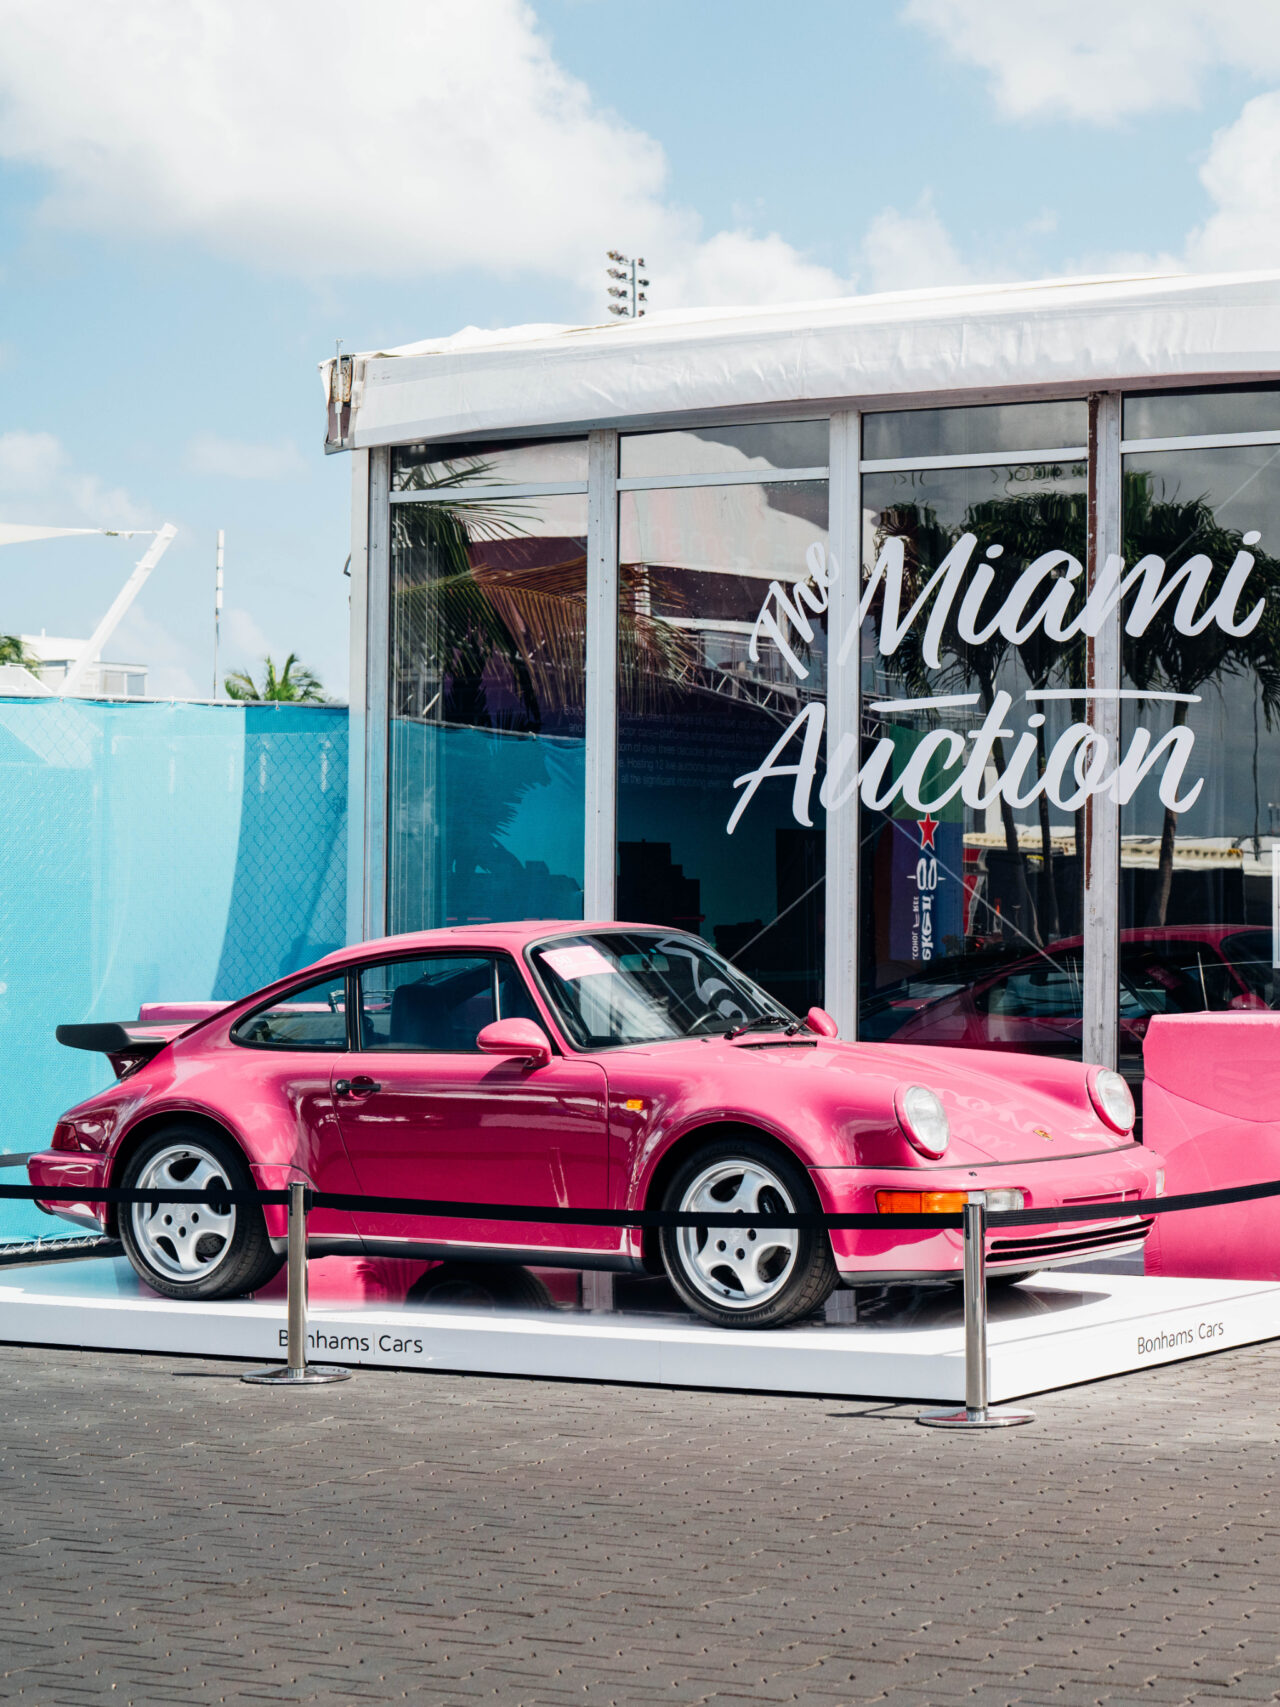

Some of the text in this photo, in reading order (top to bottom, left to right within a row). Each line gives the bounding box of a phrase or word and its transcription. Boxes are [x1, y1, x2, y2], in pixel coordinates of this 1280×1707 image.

[748, 530, 1265, 680] The Miami
[725, 690, 1205, 835] Auction
[279, 1329, 424, 1354] Bnhams Cars
[1137, 1322, 1225, 1355] Bonhams Cars
